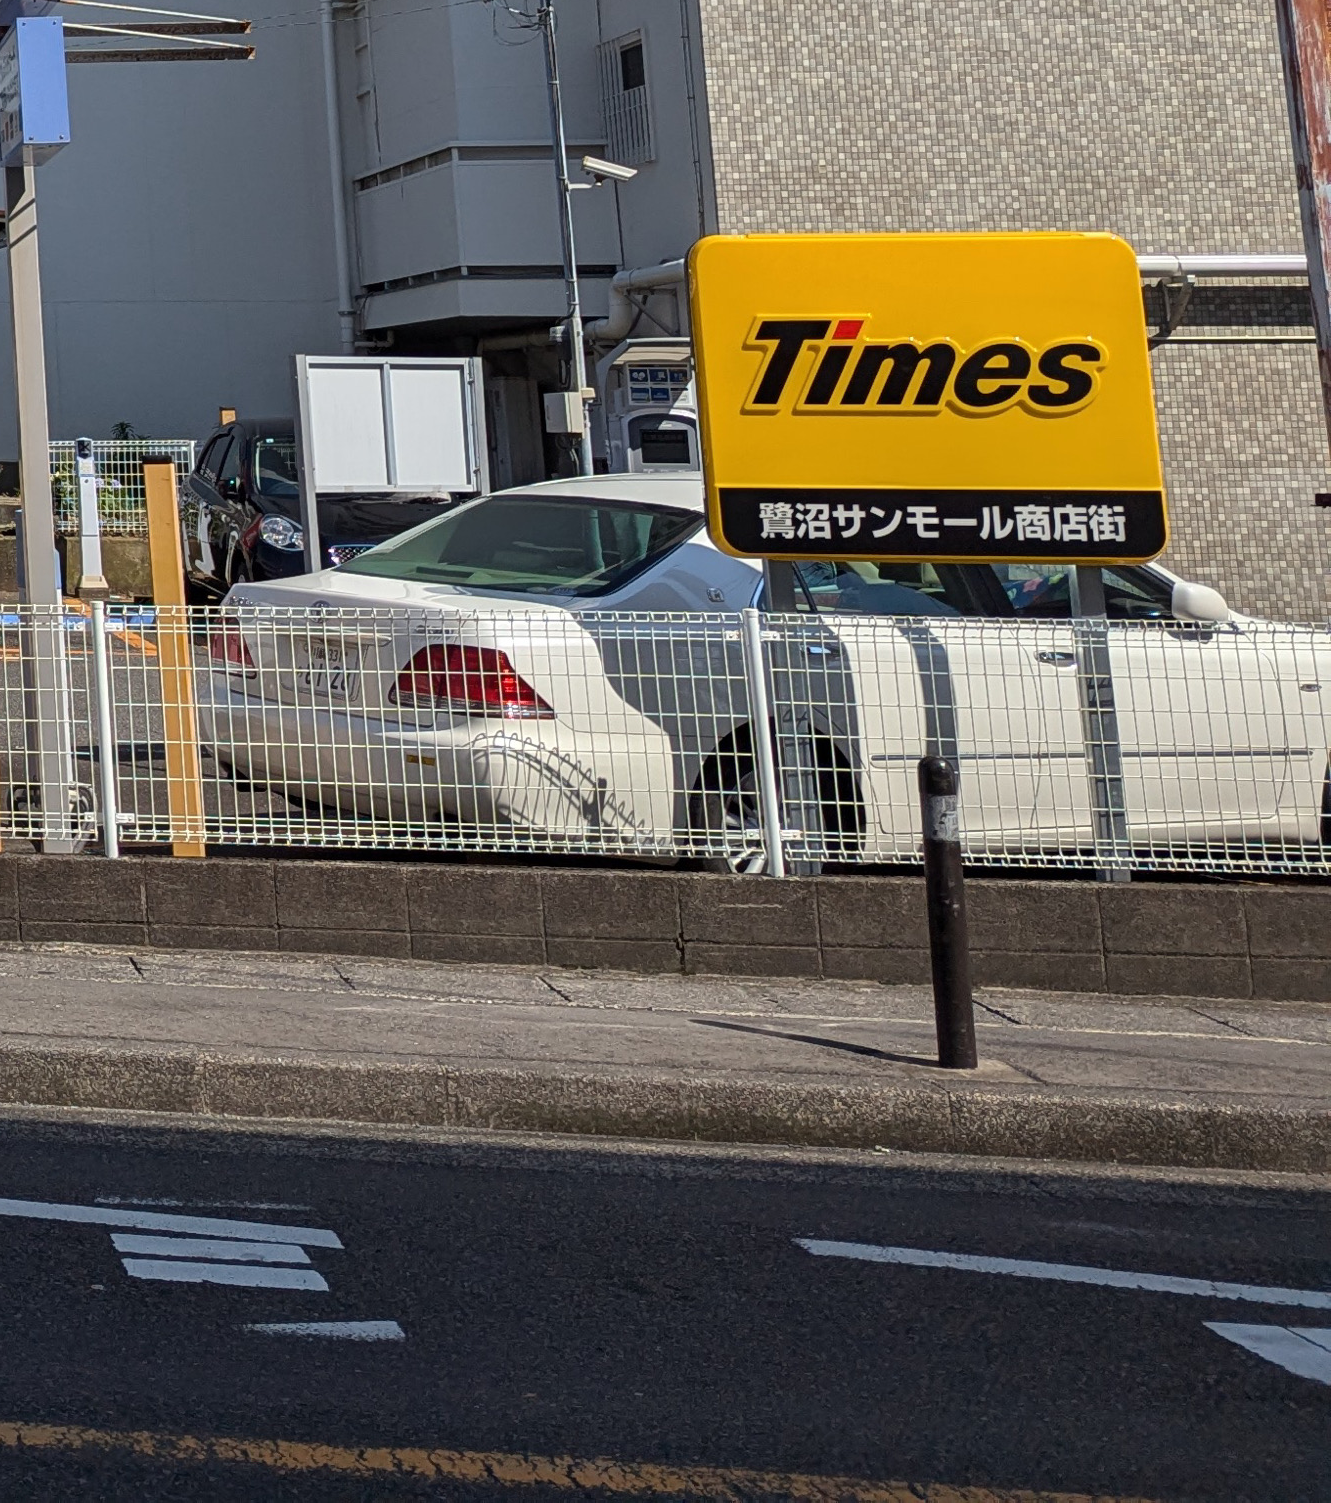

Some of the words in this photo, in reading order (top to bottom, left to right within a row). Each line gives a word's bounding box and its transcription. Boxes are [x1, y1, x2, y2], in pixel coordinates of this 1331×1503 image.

[752, 319, 1102, 407] Times
[759, 501, 1127, 542] 鷺沼サンモール商店街
